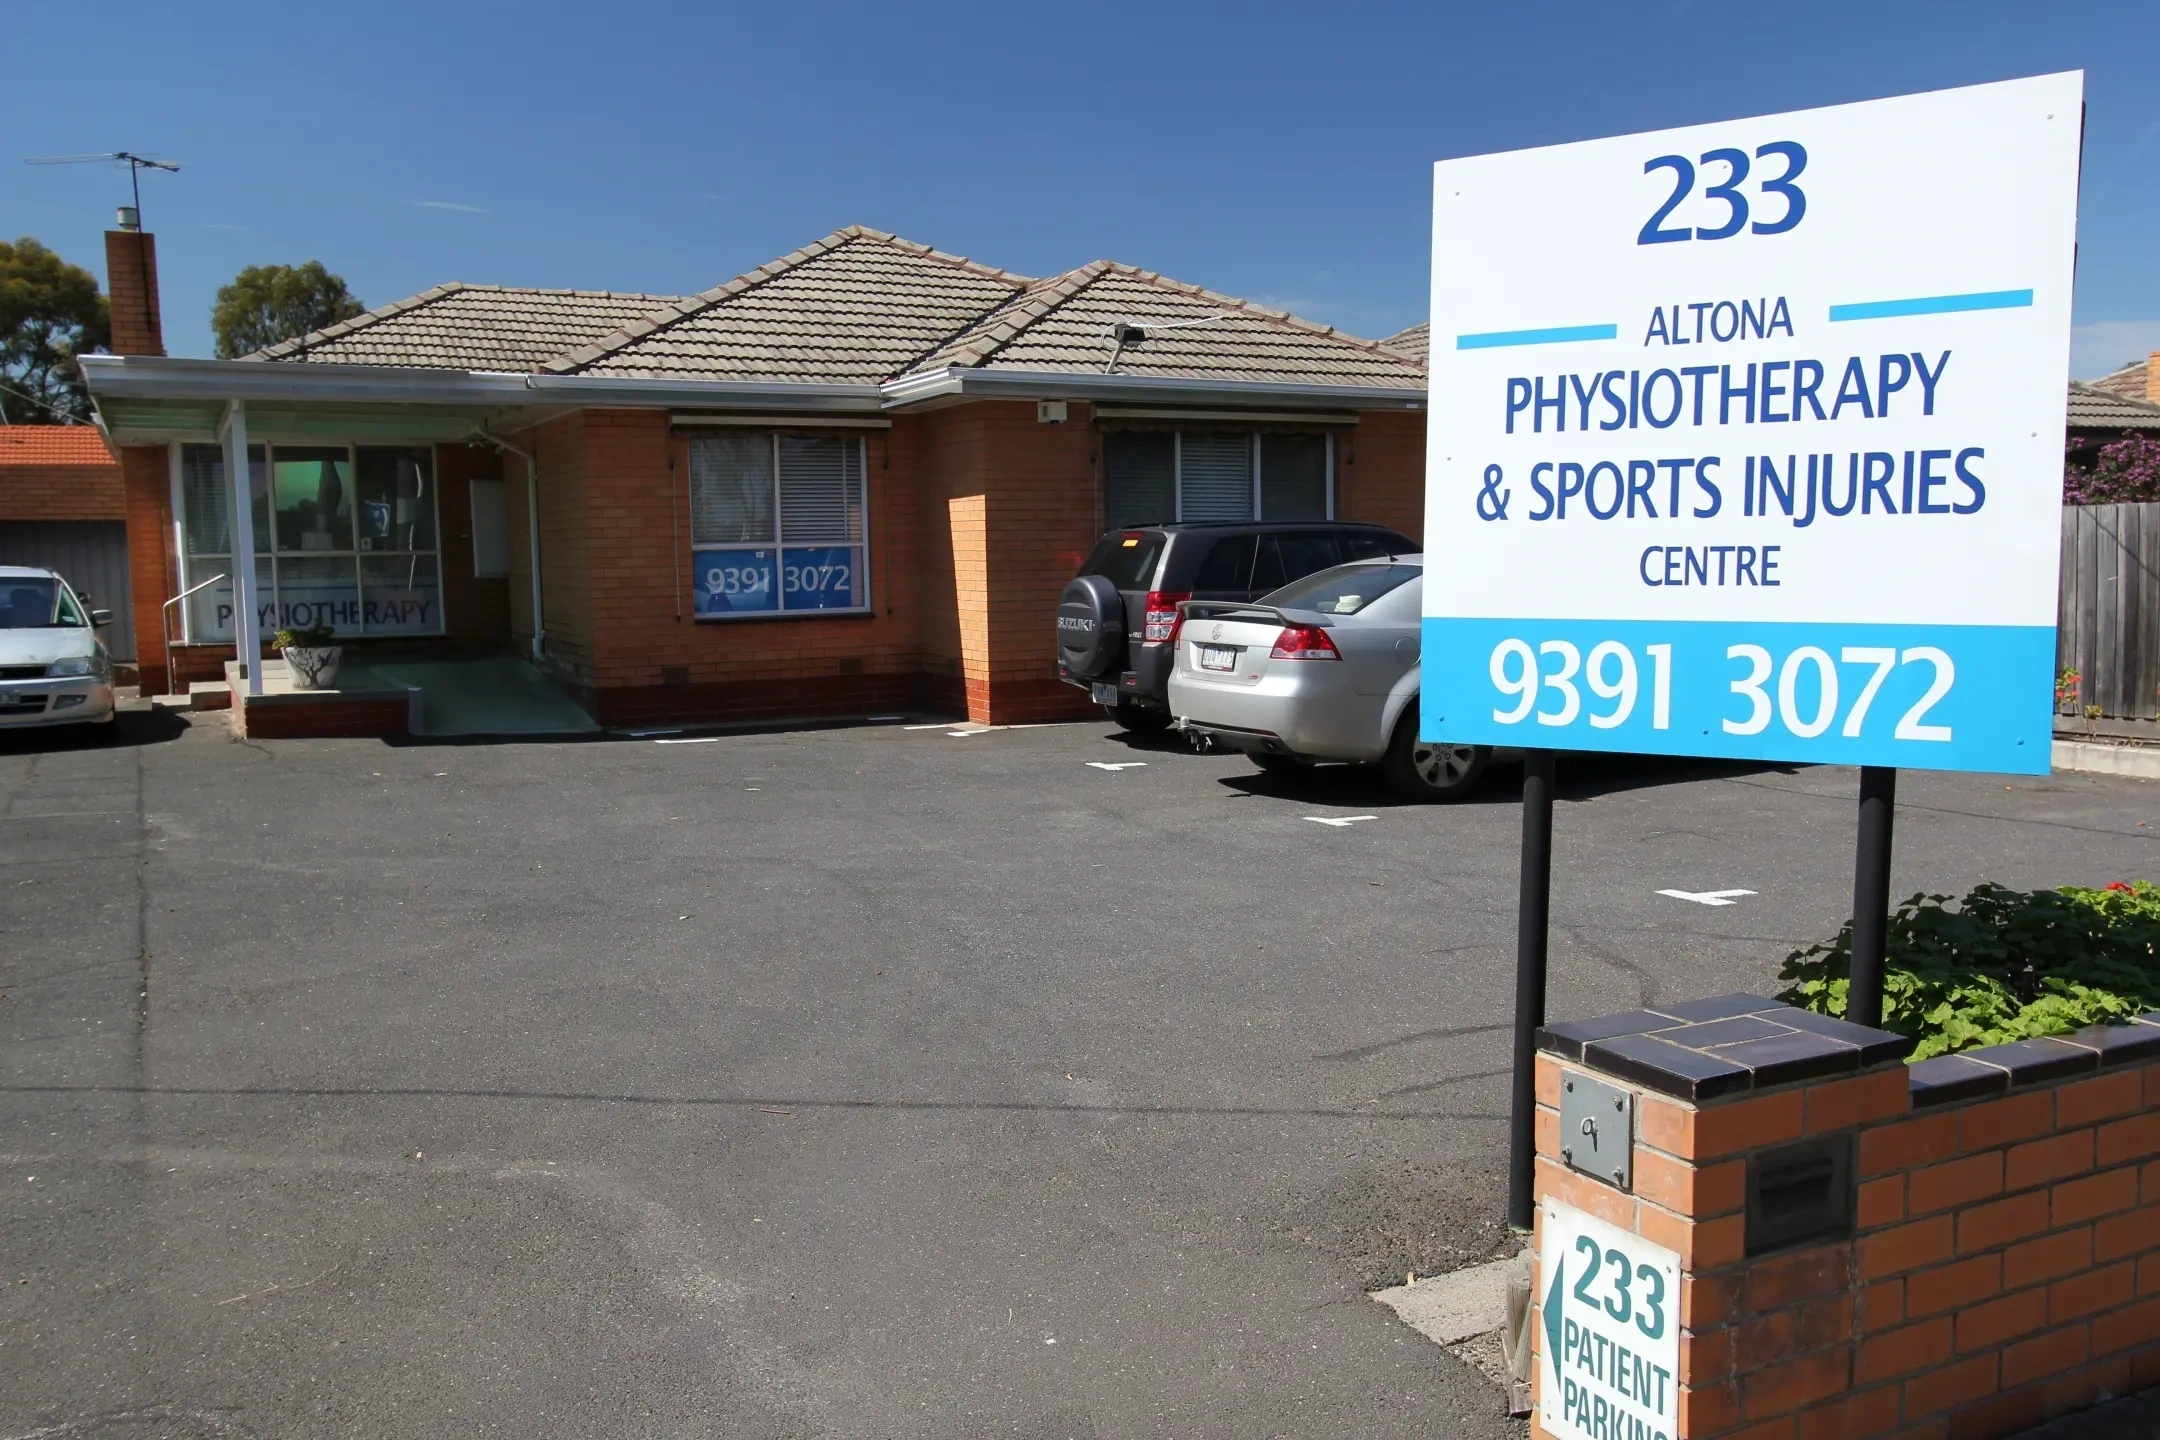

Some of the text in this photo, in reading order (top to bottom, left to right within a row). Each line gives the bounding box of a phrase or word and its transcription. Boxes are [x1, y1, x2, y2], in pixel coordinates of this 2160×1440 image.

[1637, 141, 1808, 246] 233
[1645, 296, 1794, 347] ALTONA
[1505, 350, 1952, 434] PHYSIOTHERAPY
[1476, 446, 1986, 528] & SPORTS INJURIES
[707, 565, 850, 595] 9391 3072
[1639, 545, 1781, 587] CENTRE
[217, 600, 430, 629] PYSIOTHERAPY
[1057, 616, 1094, 632] SUZUKI
[1489, 638, 1956, 742] 9391 3072
[1573, 1234, 1665, 1340] 233
[1564, 1316, 1671, 1416] PATIENT
